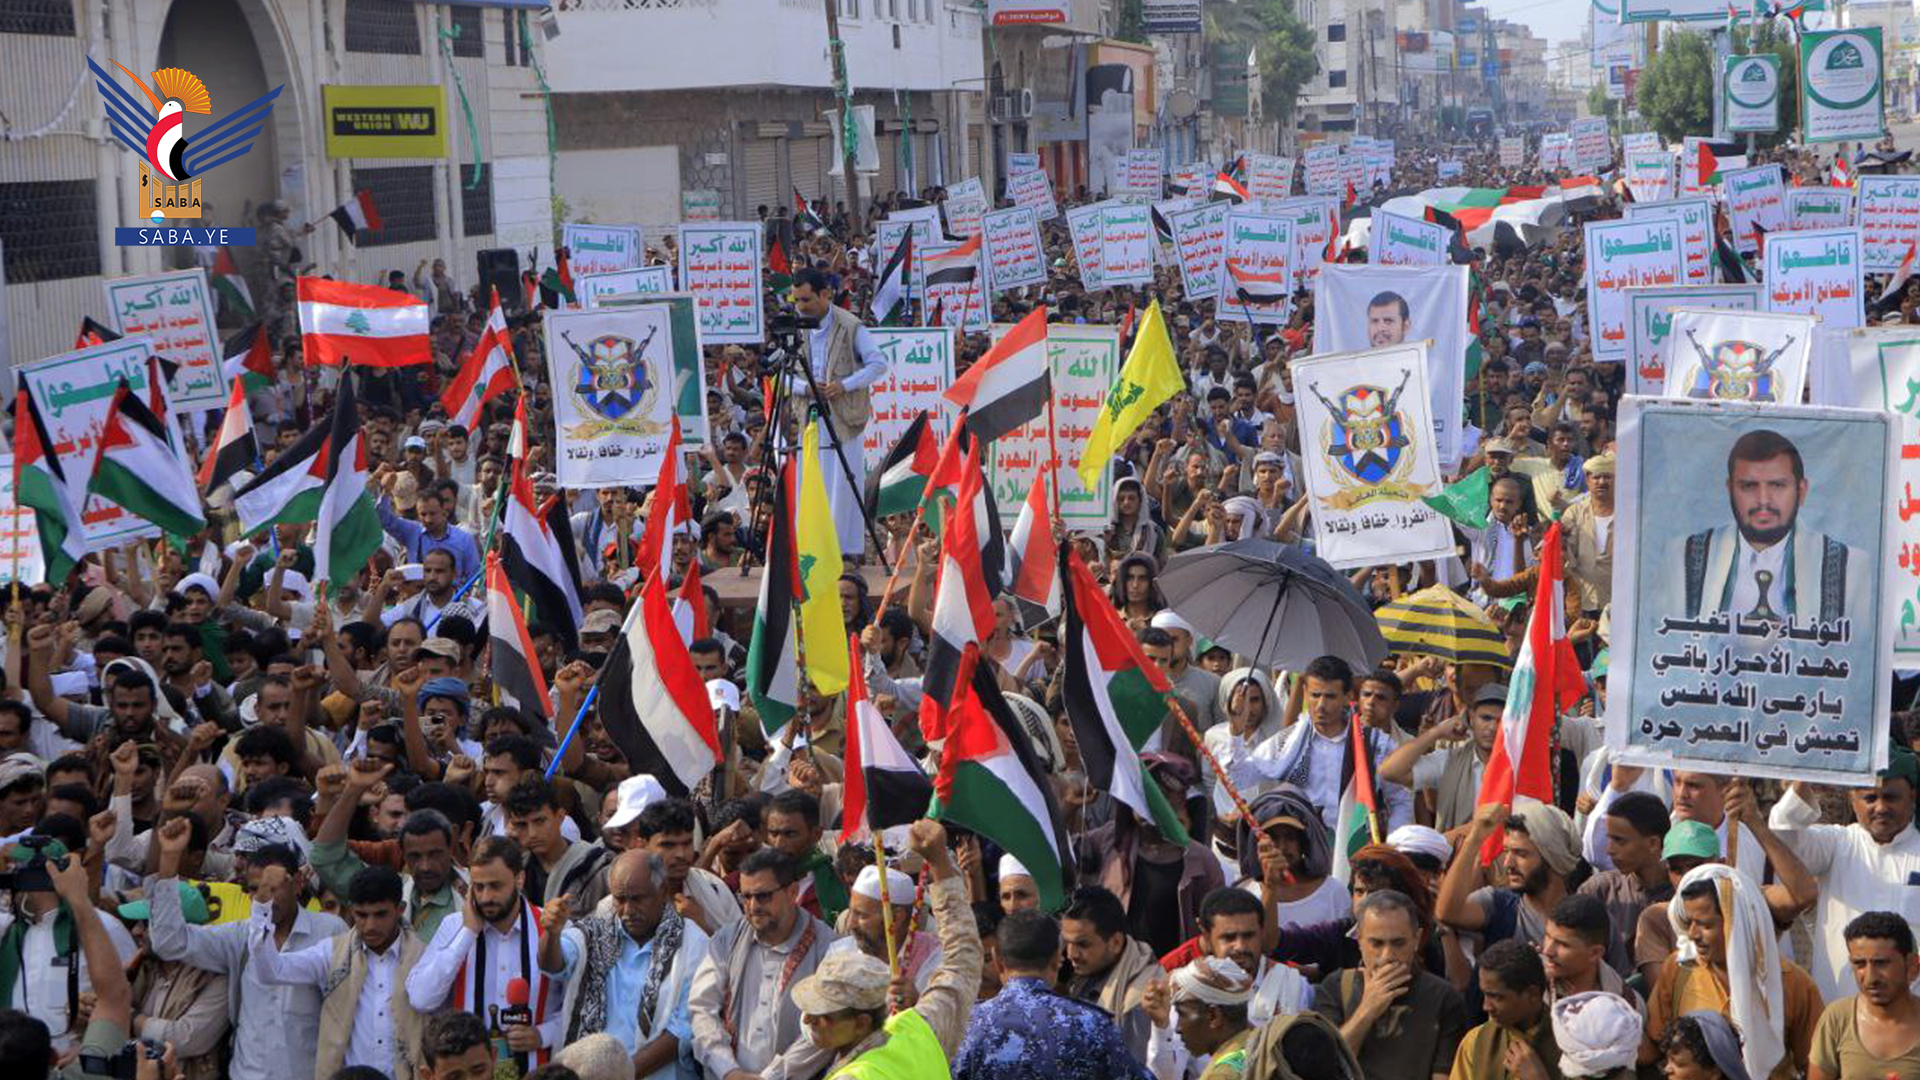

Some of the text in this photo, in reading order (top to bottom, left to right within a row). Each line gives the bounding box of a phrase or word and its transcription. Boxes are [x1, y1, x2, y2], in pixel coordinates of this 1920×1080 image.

[337, 113, 391, 121] WESTERN
[354, 121, 391, 130] UNION
[398, 113, 429, 130] WU
[688, 234, 753, 258] الله أكبر
[1233, 223, 1287, 245] قاطعوا
[1388, 220, 1437, 252] قاطعوا
[1599, 226, 1673, 263] قاطعوا
[1777, 240, 1851, 275] قاطعوا
[122, 284, 200, 317] الله أكبر
[905, 338, 942, 364] الله
[1068, 348, 1108, 378] الله
[36, 356, 147, 418] قاطعوا
[901, 374, 942, 395] الموت
[1059, 389, 1106, 412] الموت
[997, 450, 1038, 473] اليهود
[1658, 610, 1850, 647] الوفاء ما تغير
[1652, 644, 1708, 676] باقي
[1796, 656, 1849, 679] عهد
[1661, 682, 1843, 719] يارعى الله نفس
[1641, 716, 1860, 755] تعيش في العمر حره
